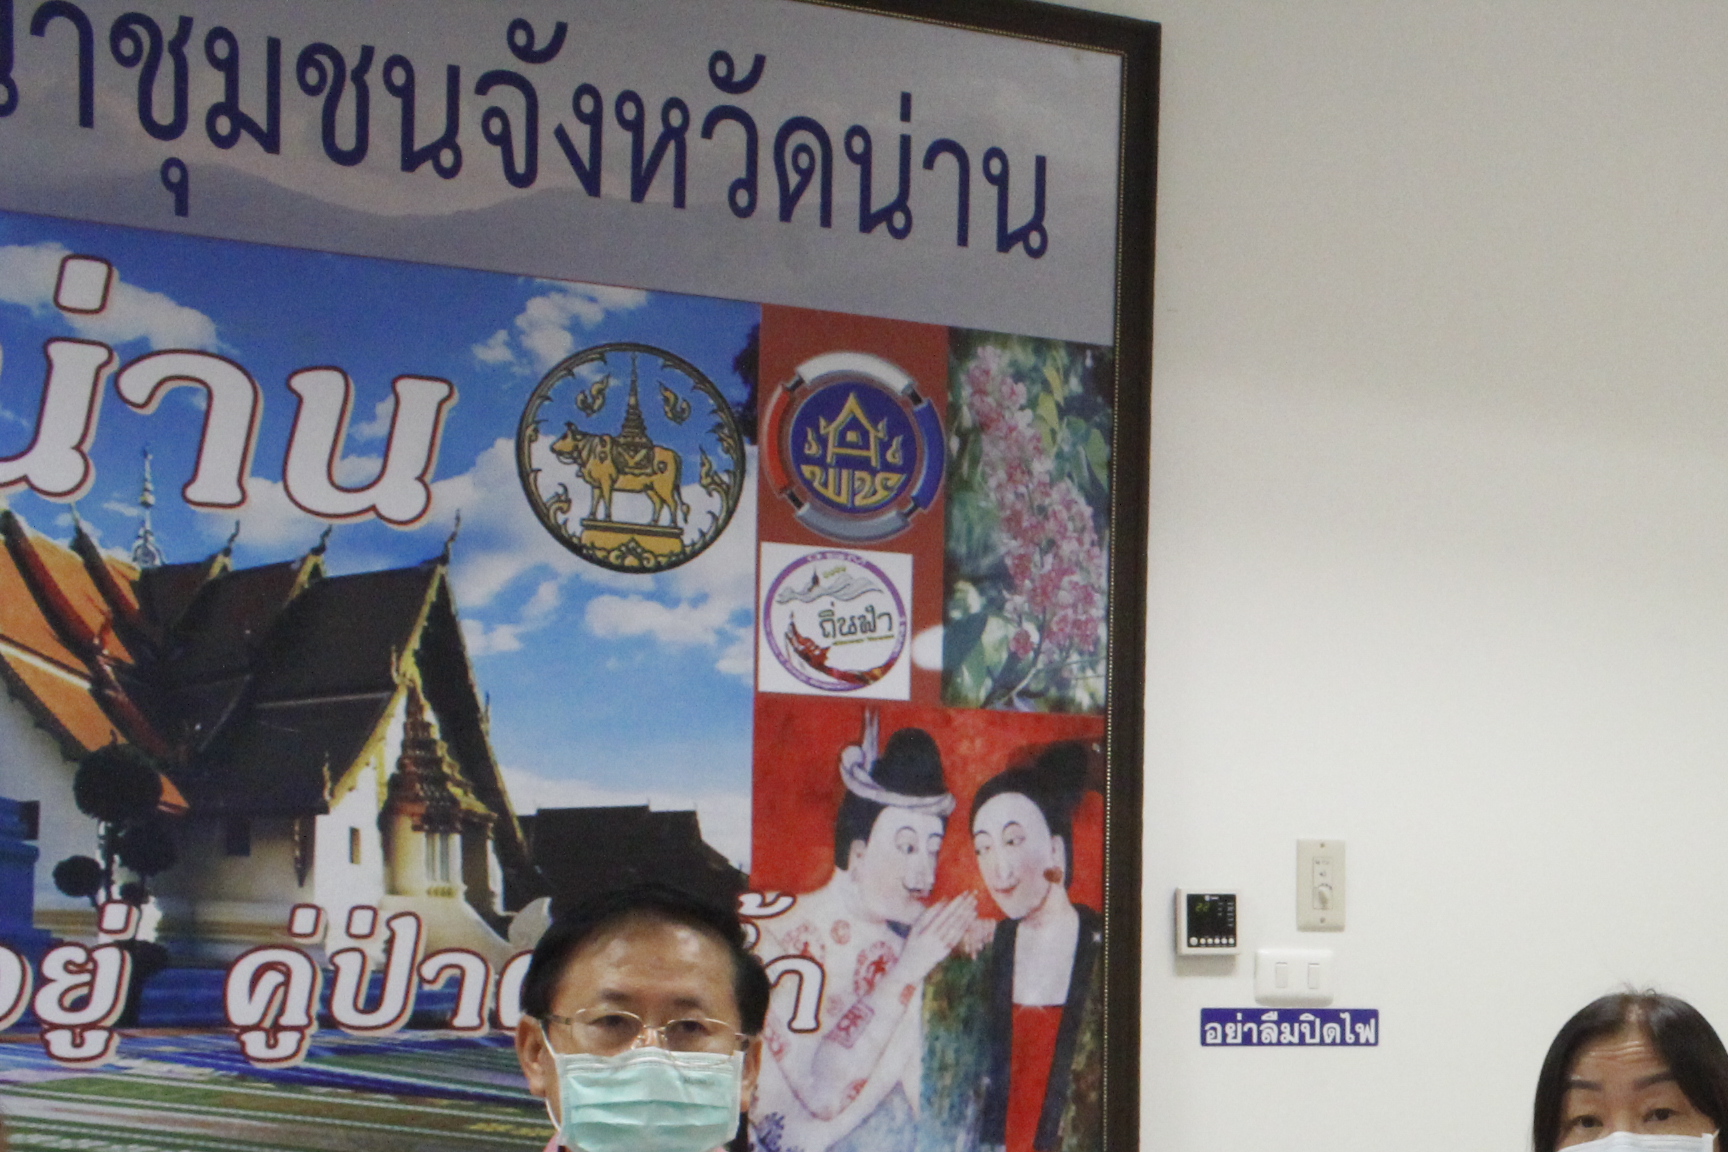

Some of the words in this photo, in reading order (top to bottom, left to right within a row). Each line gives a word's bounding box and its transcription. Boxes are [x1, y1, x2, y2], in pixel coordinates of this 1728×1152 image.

[1204, 1010, 1376, 1044] อย่าลืมปิดไฟ
